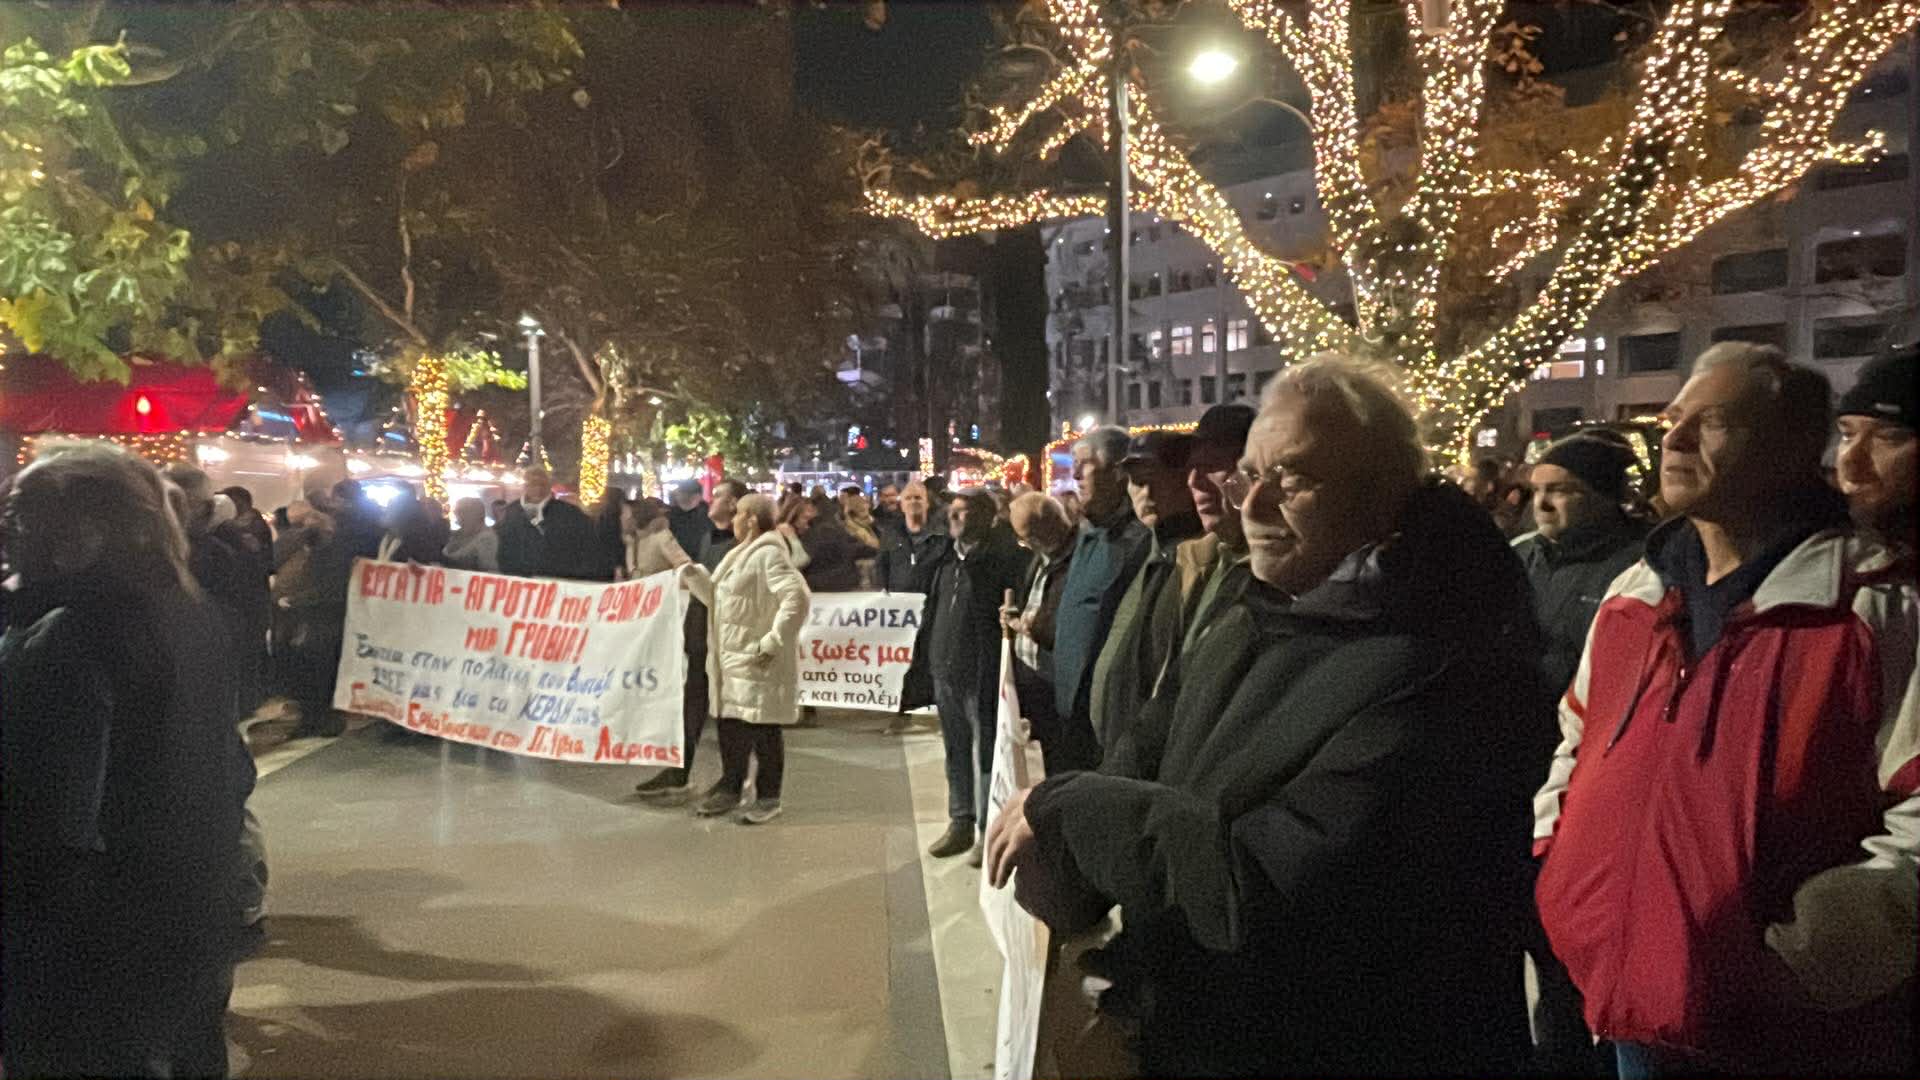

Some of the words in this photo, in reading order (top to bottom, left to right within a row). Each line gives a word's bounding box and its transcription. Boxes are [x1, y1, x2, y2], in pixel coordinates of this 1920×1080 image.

[465, 575, 559, 620] ΑΓΡΟΤΙΑ
[811, 639, 871, 666] ζωές
[877, 645, 912, 668] μα
[802, 668, 837, 683] από
[844, 672, 883, 688] τους
[811, 690, 837, 702] και
[844, 690, 898, 706] πολέμ
